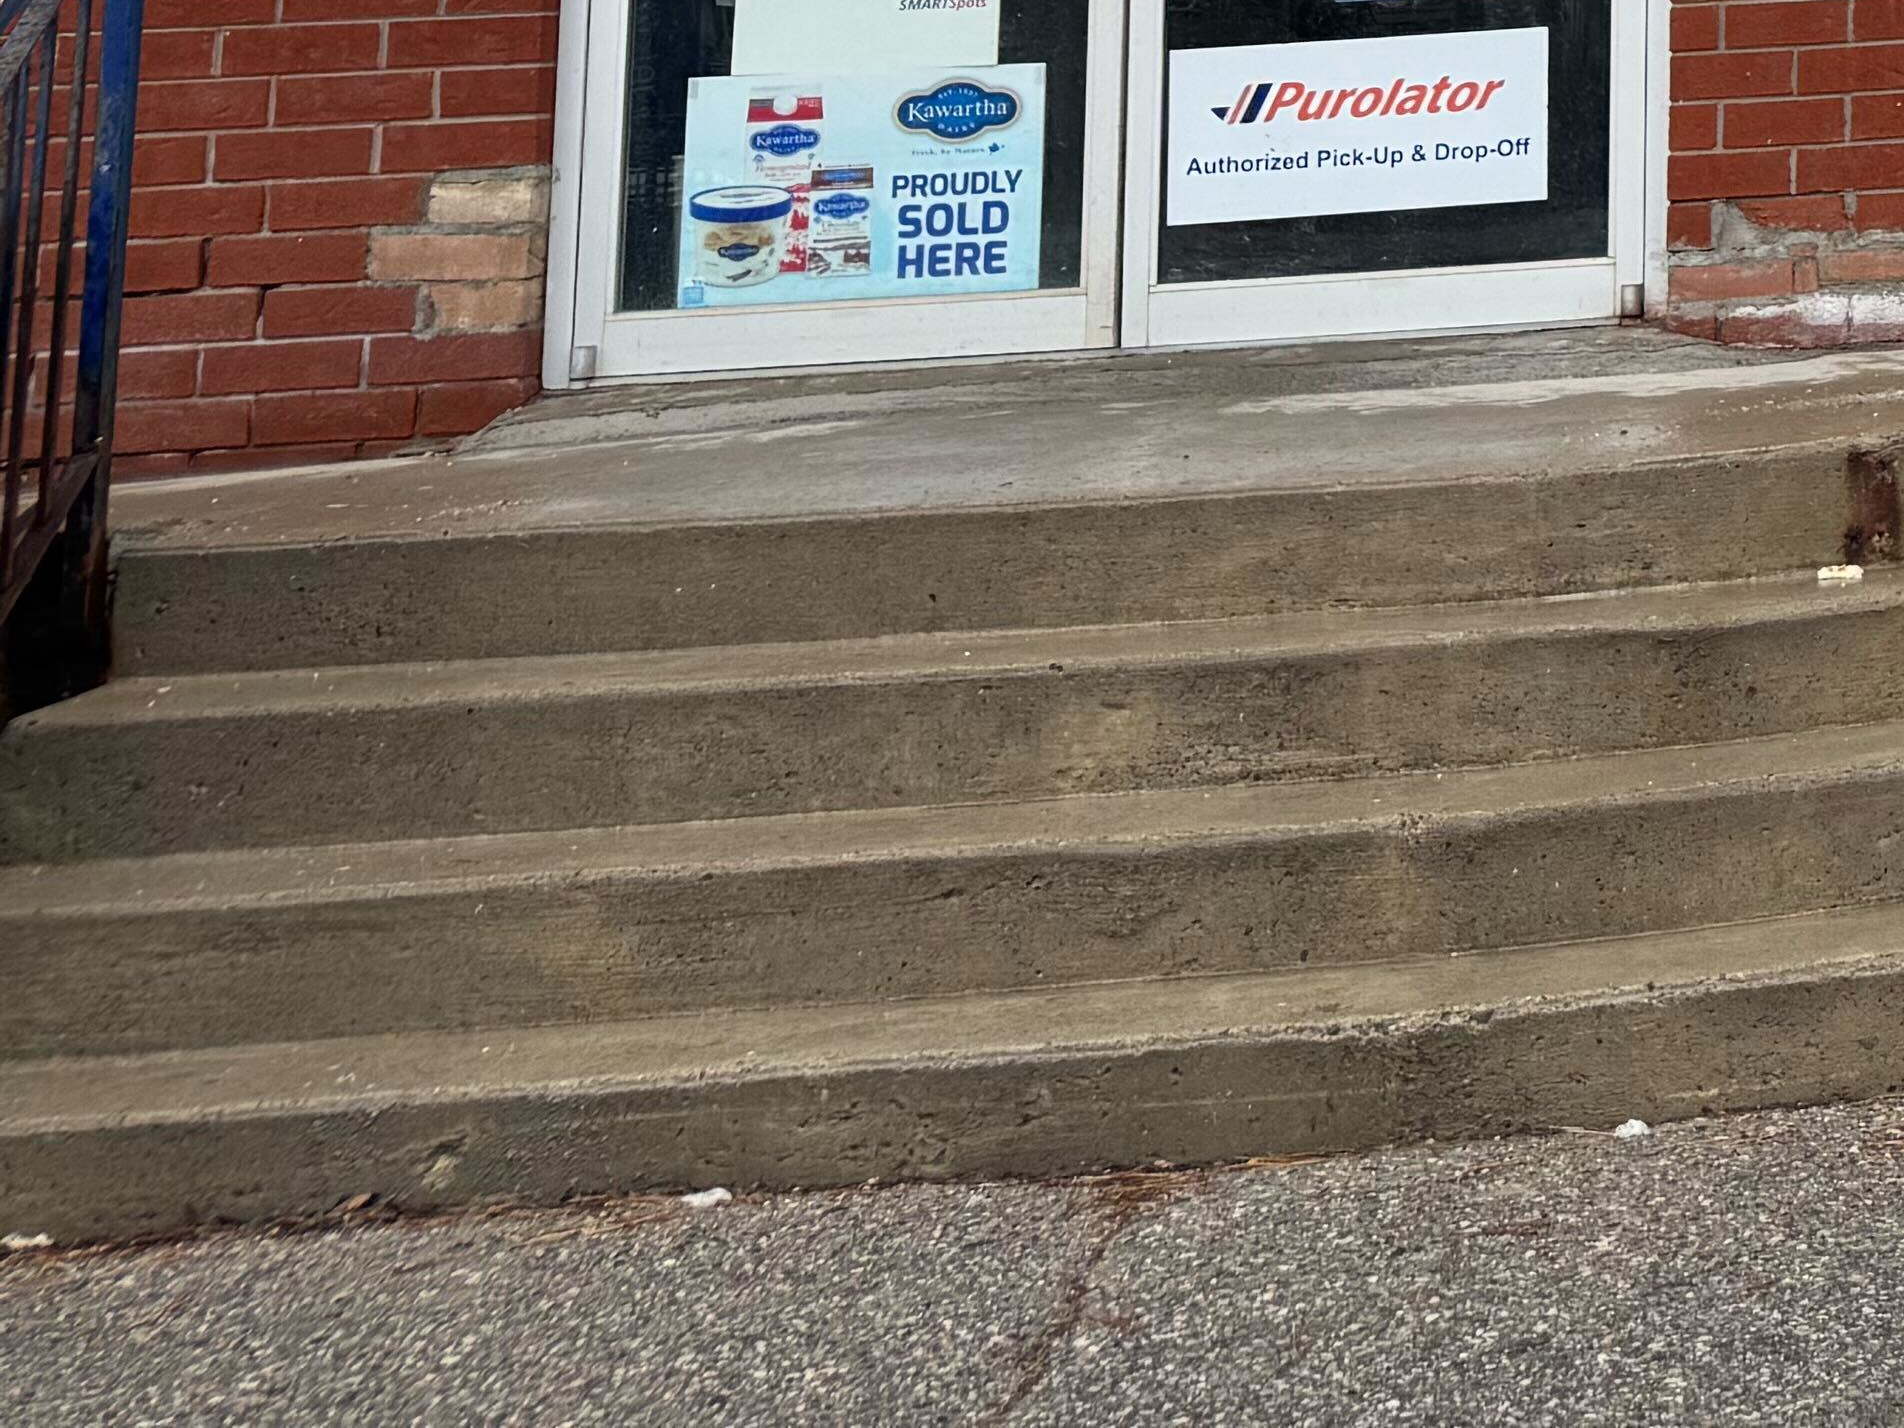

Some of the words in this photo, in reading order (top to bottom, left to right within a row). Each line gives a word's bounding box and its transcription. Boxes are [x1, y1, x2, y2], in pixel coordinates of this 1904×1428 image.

[907, 98, 1008, 123] Kawartha
[1263, 75, 1506, 124] Purolator
[1186, 148, 1310, 176] Authorized
[1317, 145, 1404, 170] Pick-Up
[1411, 144, 1427, 162] &
[1434, 137, 1532, 164] Drop-Off
[891, 169, 1023, 199] PROUDLY
[898, 201, 1010, 239] SOLD
[896, 240, 1008, 280] HERE
